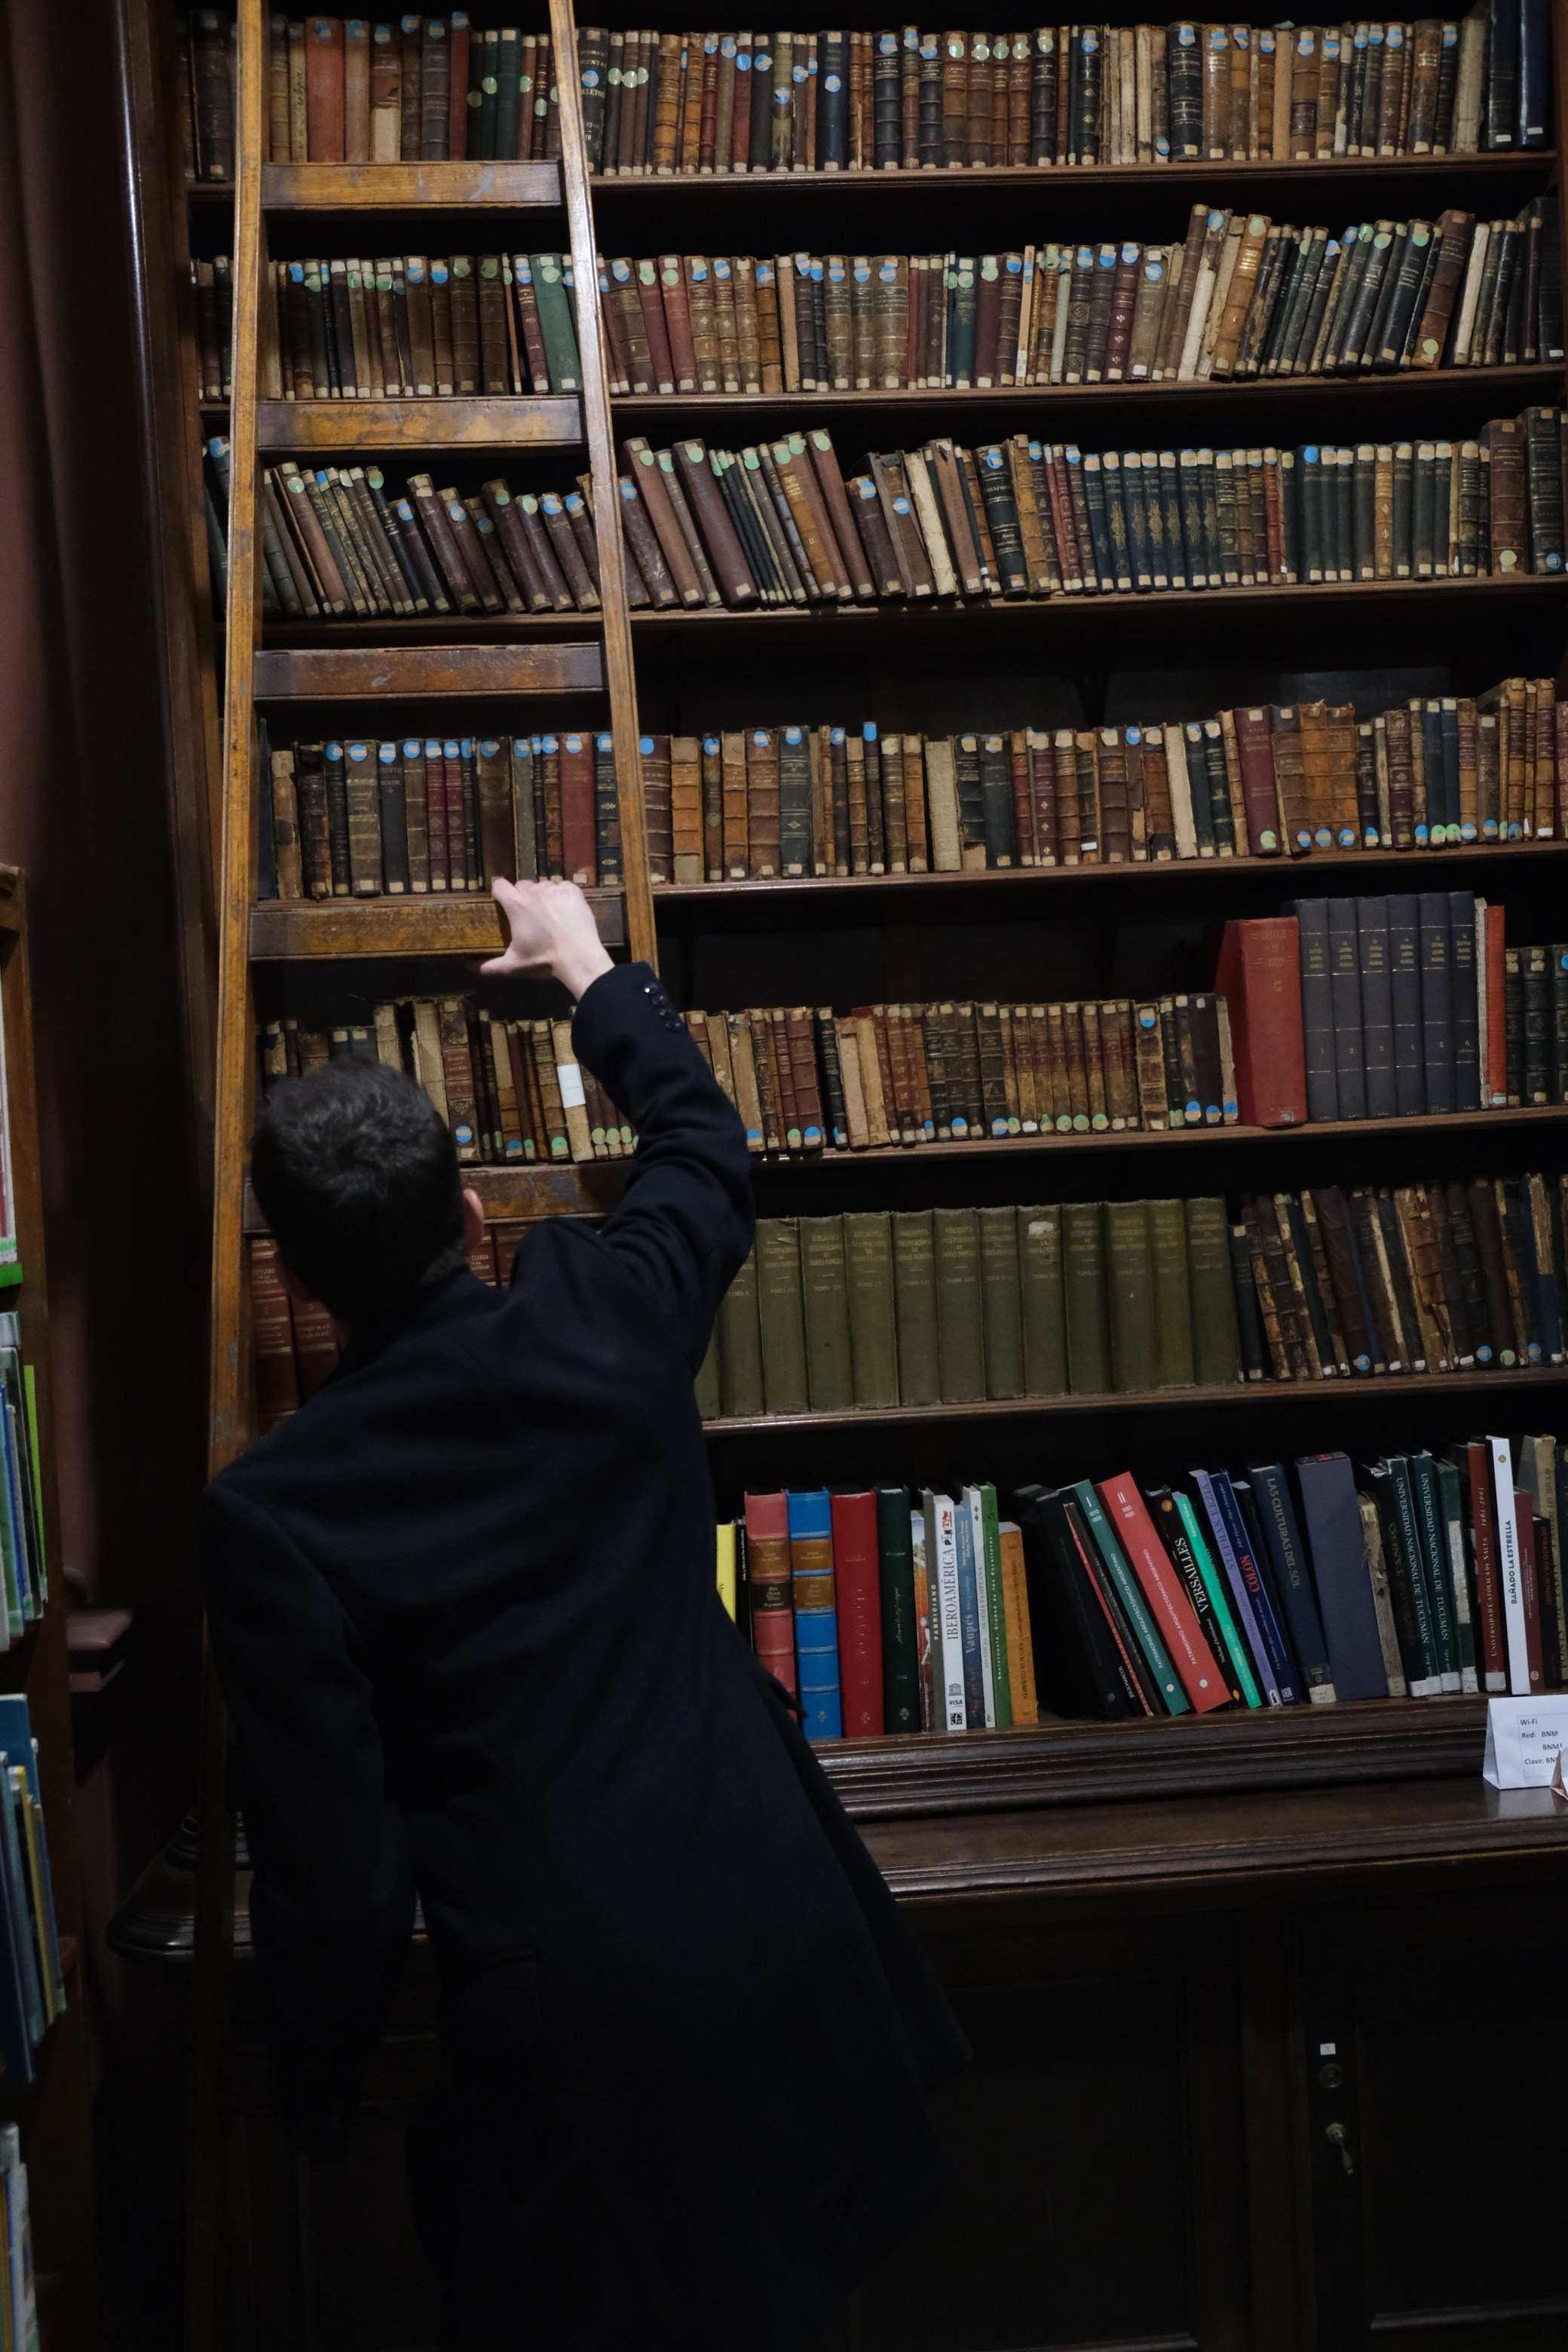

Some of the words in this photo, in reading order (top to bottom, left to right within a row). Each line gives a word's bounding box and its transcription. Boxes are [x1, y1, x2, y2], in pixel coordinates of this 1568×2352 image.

[1260, 929, 1288, 940] CHILE
[1266, 1478, 1279, 1497] LAS
[1420, 1473, 1435, 1530] UNIVERSIDAD
[1125, 1511, 1135, 1519] 1920
[1272, 1497, 1292, 1550] CULTURAS
[1396, 1478, 1413, 1536] UNIVERSIDAD
[1213, 1518, 1236, 1570] STEPHAN
[1285, 1549, 1297, 1569] DEL
[1406, 1537, 1419, 1580] NACIONAL
[1431, 1533, 1441, 1579] NACIONAL
[1505, 1521, 1514, 1559] ESTRELLA
[1110, 1553, 1128, 1586] ARGENTINO
[1143, 1549, 1160, 1582] ARGENTINO
[1174, 1537, 1209, 1613] VERSAILLES
[1239, 1554, 1260, 1593] COLÓN
[1289, 1569, 1301, 1589] SOL
[1508, 1560, 1516, 1570] LA
[941, 1548, 959, 1640] IBEROAMÉRICA
[1413, 1585, 1423, 1597] DE
[1435, 1580, 1443, 1592] DE
[1507, 1571, 1517, 1604] BAÑADO
[931, 1584, 939, 1640] FABRICIANO
[1416, 1599, 1430, 1644] TUCUMÁN
[1437, 1597, 1449, 1640] TUCUMÁN
[966, 1613, 978, 1654] Vaupés
[1145, 1634, 1164, 1669] PATRIMONIO
[1178, 1630, 1197, 1665] PATRIMONIO
[1488, 1608, 1498, 1657] UNIVERSIDAD
[1019, 1669, 1027, 1700] ALBERTO
